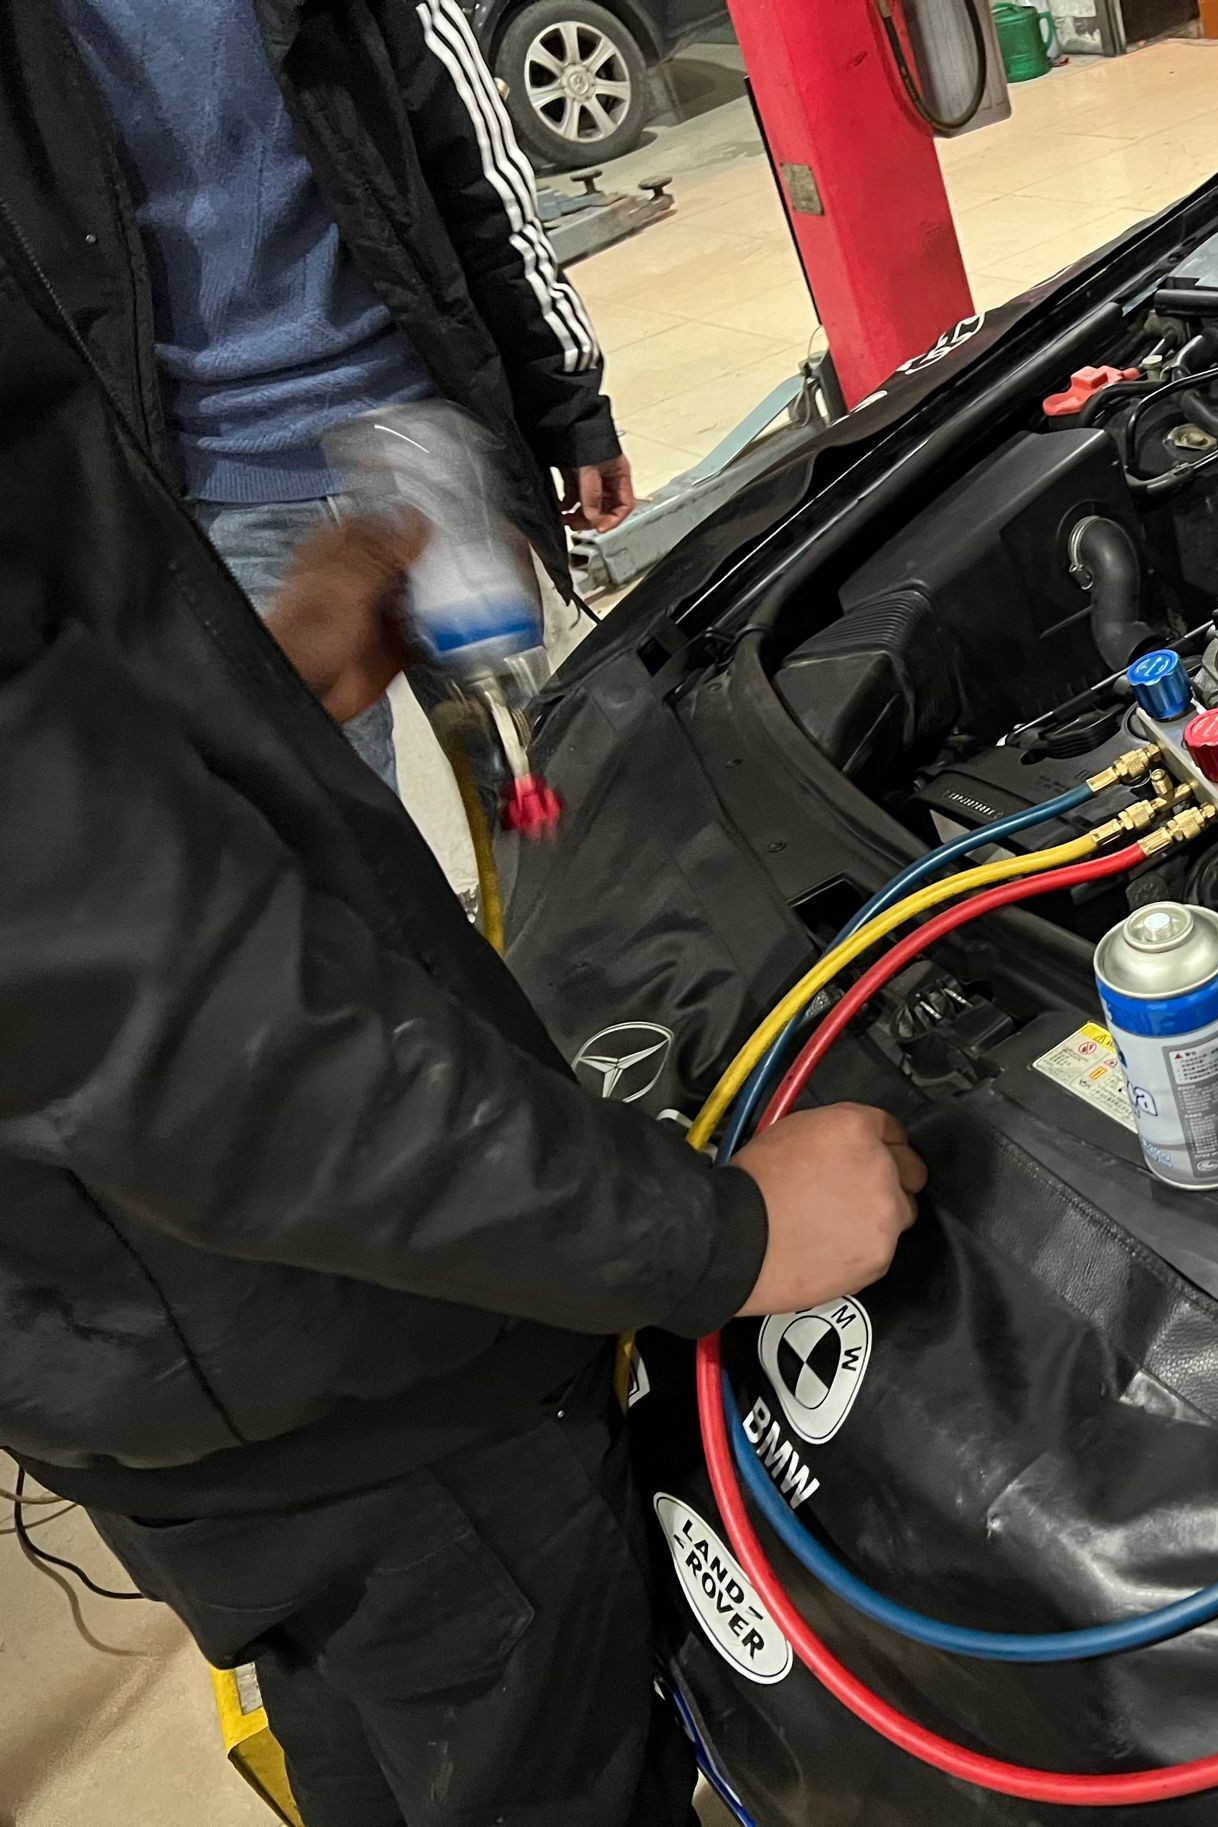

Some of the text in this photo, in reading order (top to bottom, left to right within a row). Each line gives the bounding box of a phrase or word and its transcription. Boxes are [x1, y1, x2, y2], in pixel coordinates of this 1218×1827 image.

[742, 1396, 820, 1510] BMW
[682, 1519, 745, 1604] LAND
[685, 1550, 765, 1660] ROVER
